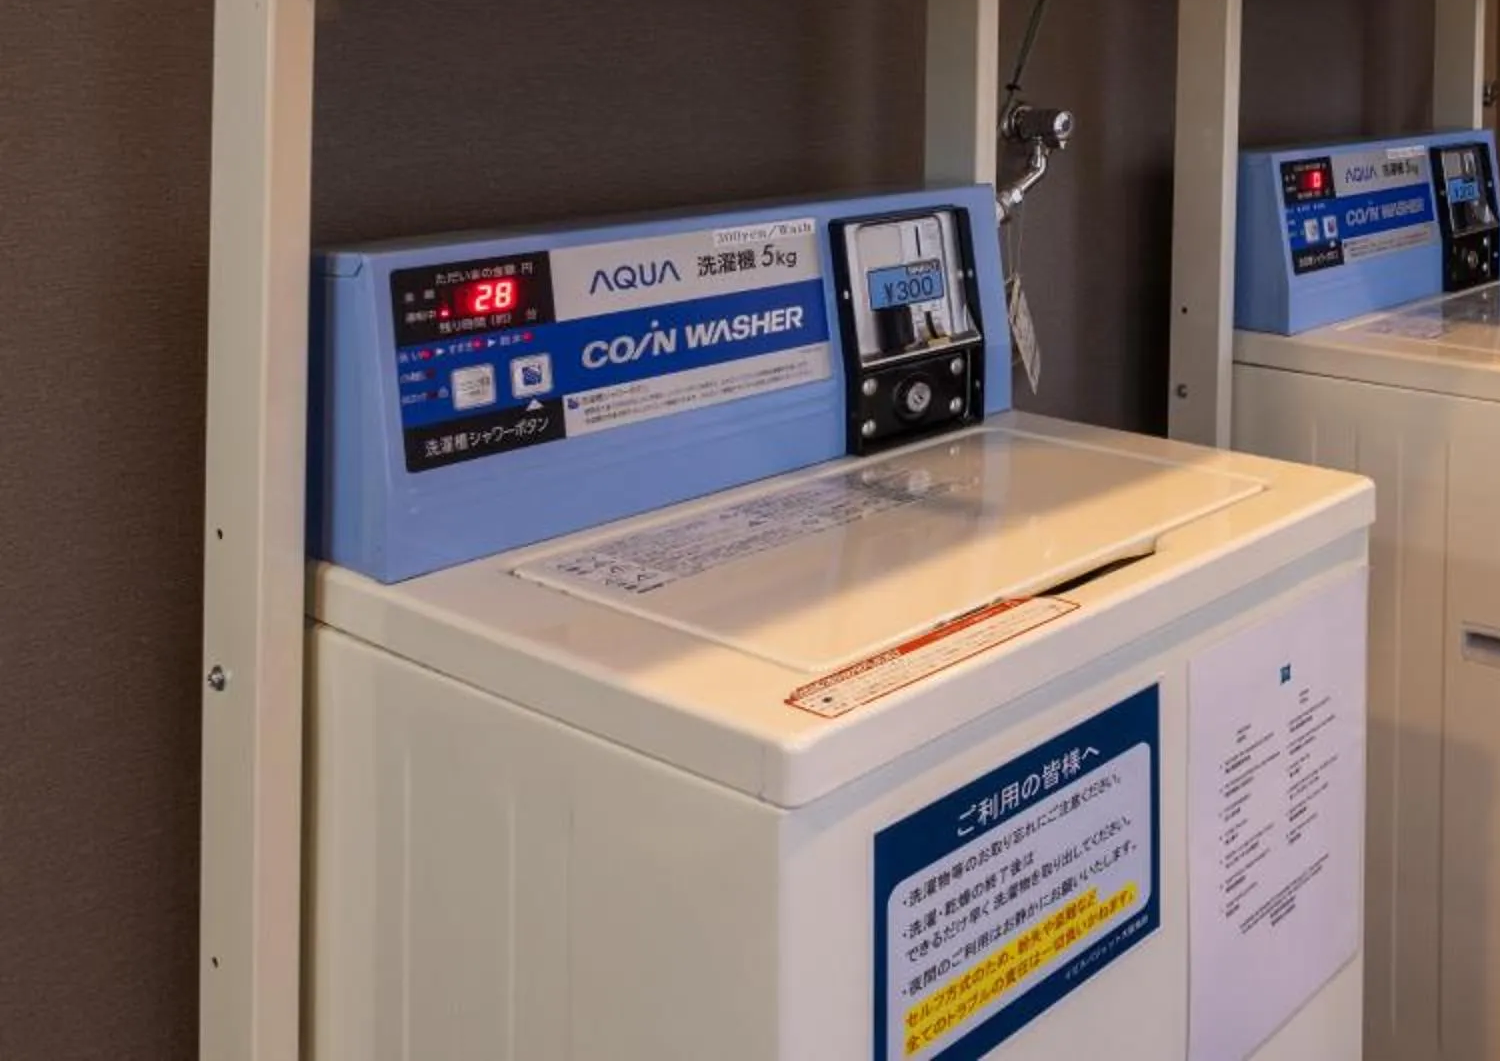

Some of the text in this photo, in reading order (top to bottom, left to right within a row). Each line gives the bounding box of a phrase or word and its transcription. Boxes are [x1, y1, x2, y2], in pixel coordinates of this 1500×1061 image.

[1345, 163, 1377, 183] AQUA
[1346, 197, 1424, 225] COIN WASHER
[697, 244, 798, 277] 洗濯機 5kg
[590, 261, 681, 295] AQUA
[883, 276, 933, 303] ¥300
[474, 281, 513, 312] 28
[582, 306, 803, 369] COIN WASHER
[425, 416, 549, 458] 洗濯槽シャワーボタン
[957, 746, 1100, 837] ご利用の皆様へ
